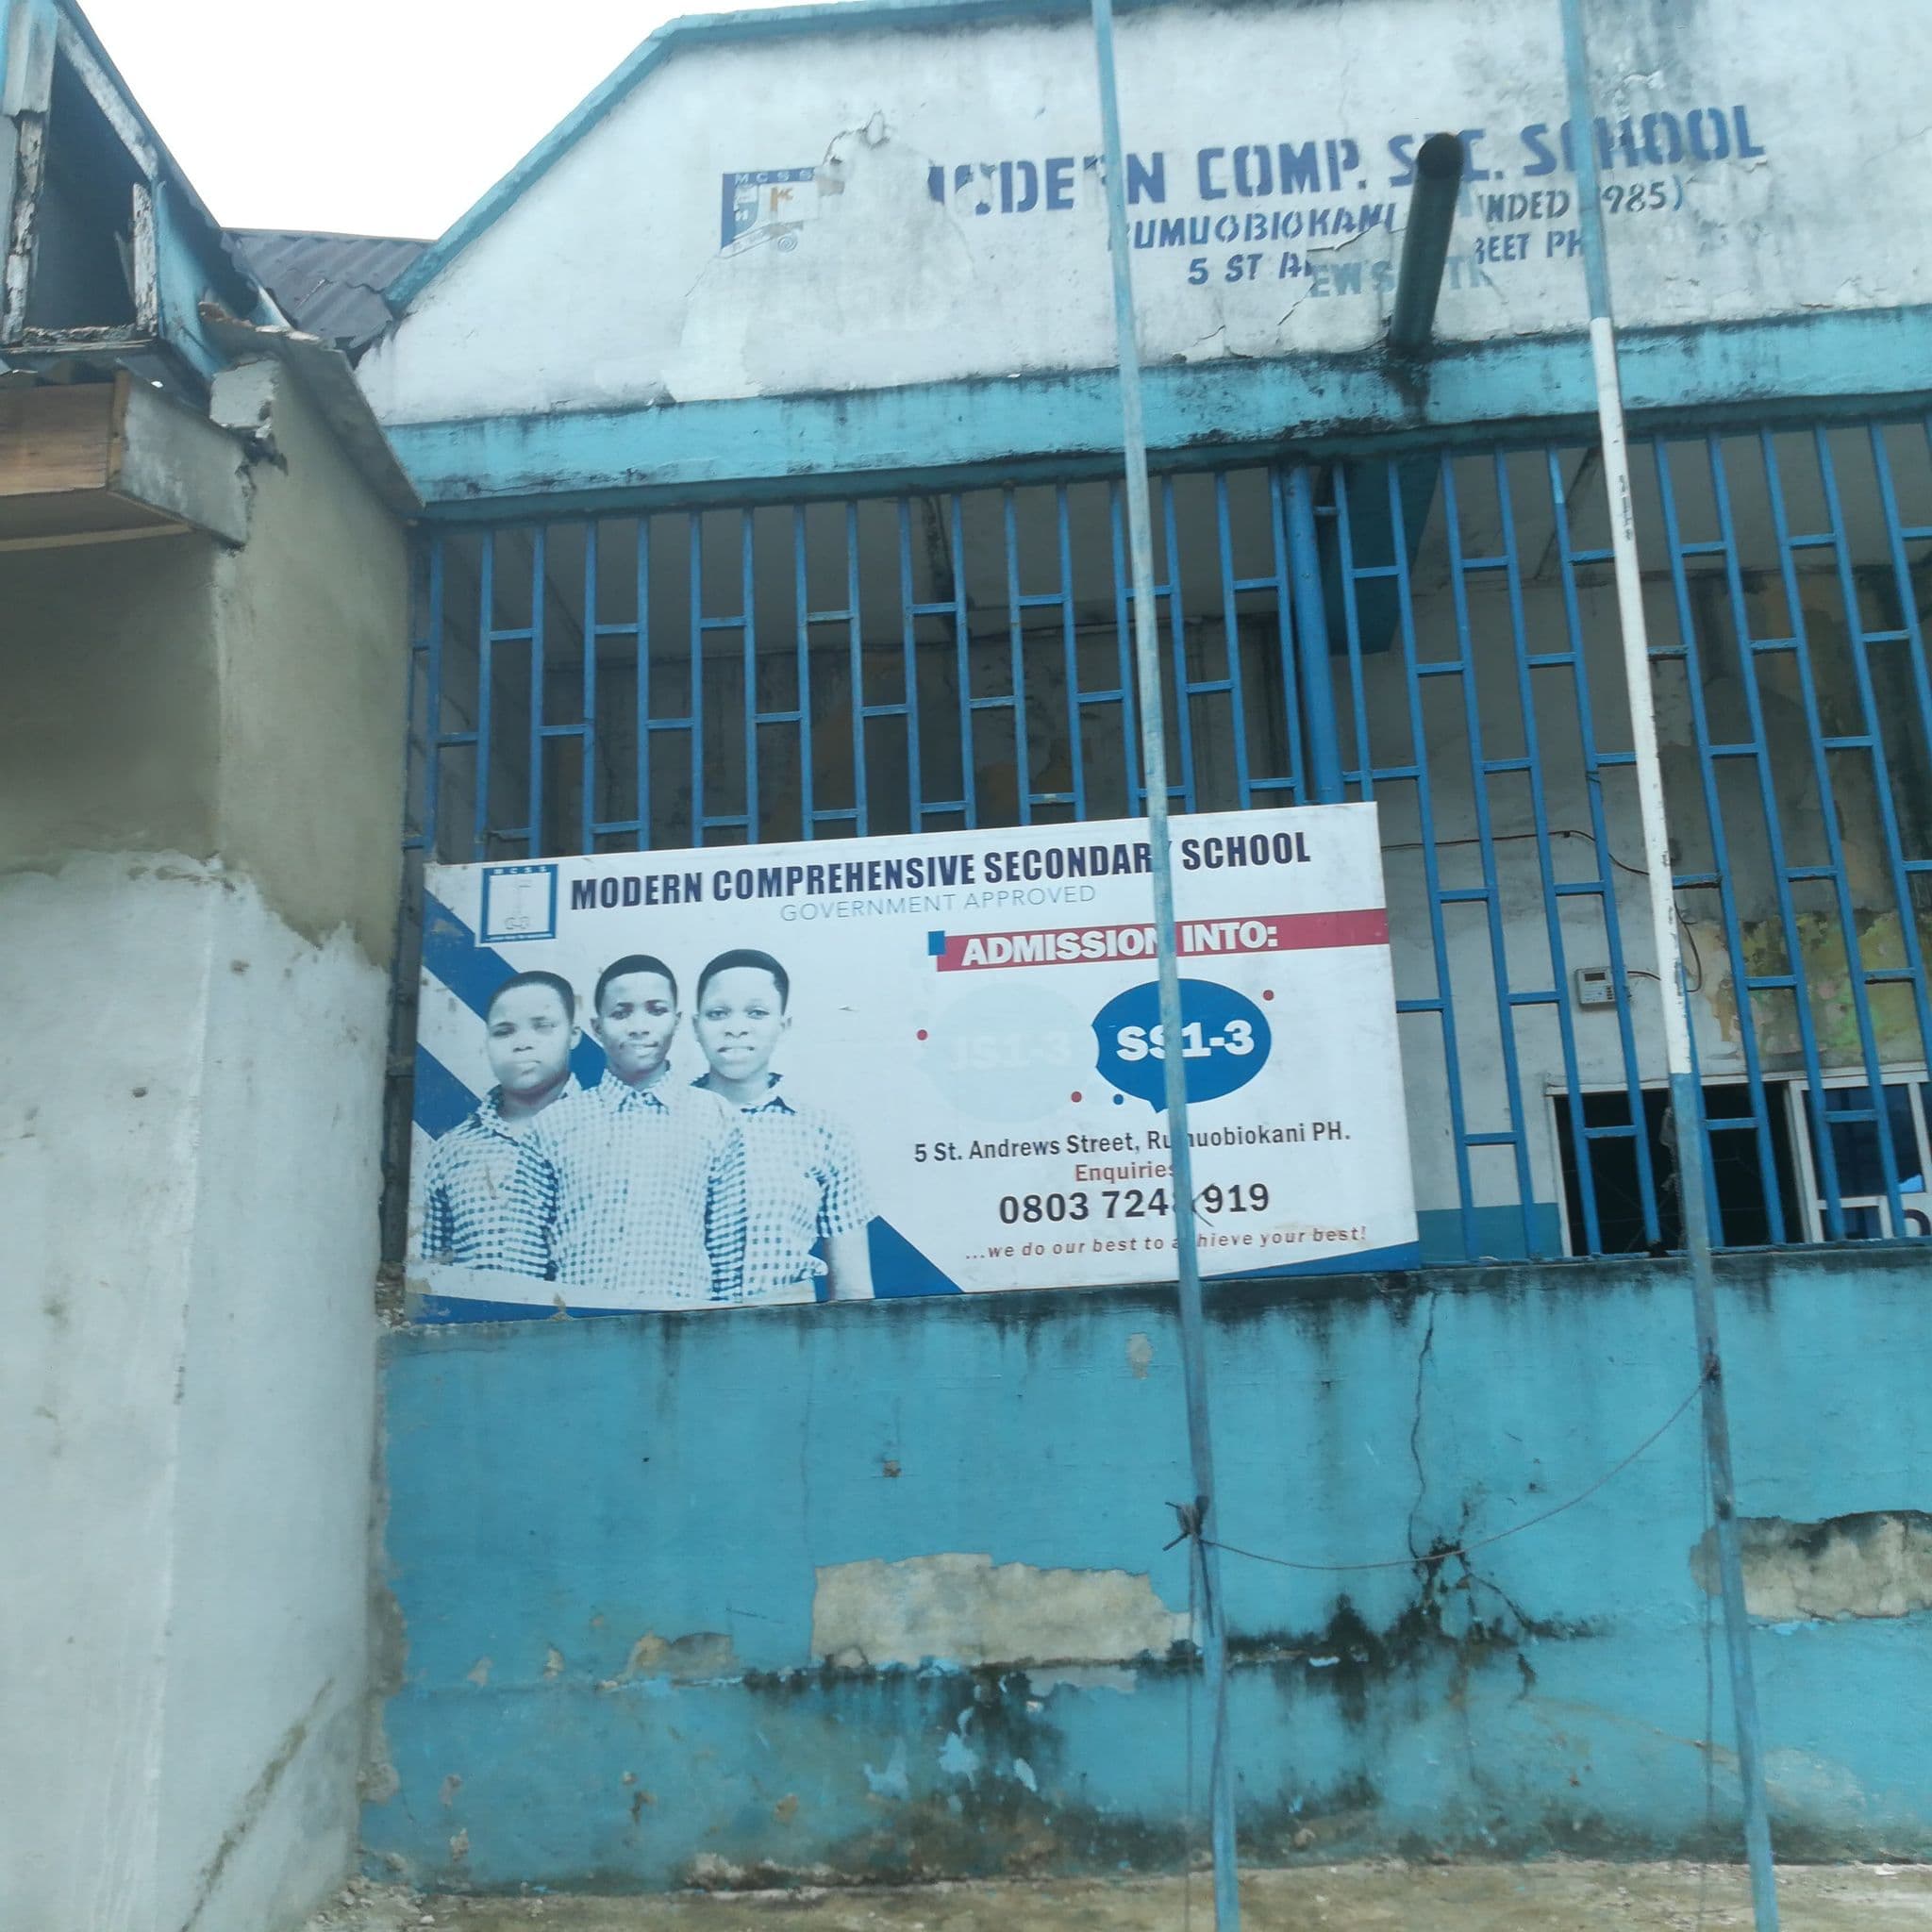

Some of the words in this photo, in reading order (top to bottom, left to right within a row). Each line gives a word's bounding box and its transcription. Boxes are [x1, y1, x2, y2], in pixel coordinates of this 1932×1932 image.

[1197, 139, 1367, 201] COMP.
[1388, 127, 1504, 188] SC.
[1108, 203, 1396, 251] UMUOBIOKANI
[1188, 258, 1208, 284] 5
[1224, 253, 1262, 282] ST
[571, 872, 703, 910] MODERN
[712, 853, 975, 902] COMPREHENSIVE
[983, 842, 1173, 884] SECONDAR
[1181, 831, 1312, 872] SCHOOL
[779, 894, 956, 922] GOVERNMENT
[963, 885, 1096, 910] APPROVED
[1181, 920, 1279, 953] INTO:
[914, 1143, 927, 1163] 5
[934, 1141, 963, 1161] St.
[968, 1139, 1060, 1159] Andrews
[1066, 1132, 1141, 1155] Street,
[1312, 1121, 1351, 1141] PH.
[999, 1191, 1089, 1224] 0803
[1022, 1241, 1044, 1257] do
[1052, 1241, 1085, 1255] our
[1092, 1238, 1137, 1253] best
[1144, 1238, 1164, 1250] to
[1172, 1232, 1253, 1249] ahieve
[1260, 1230, 1305, 1247] your
[1312, 1225, 1367, 1242] best!
